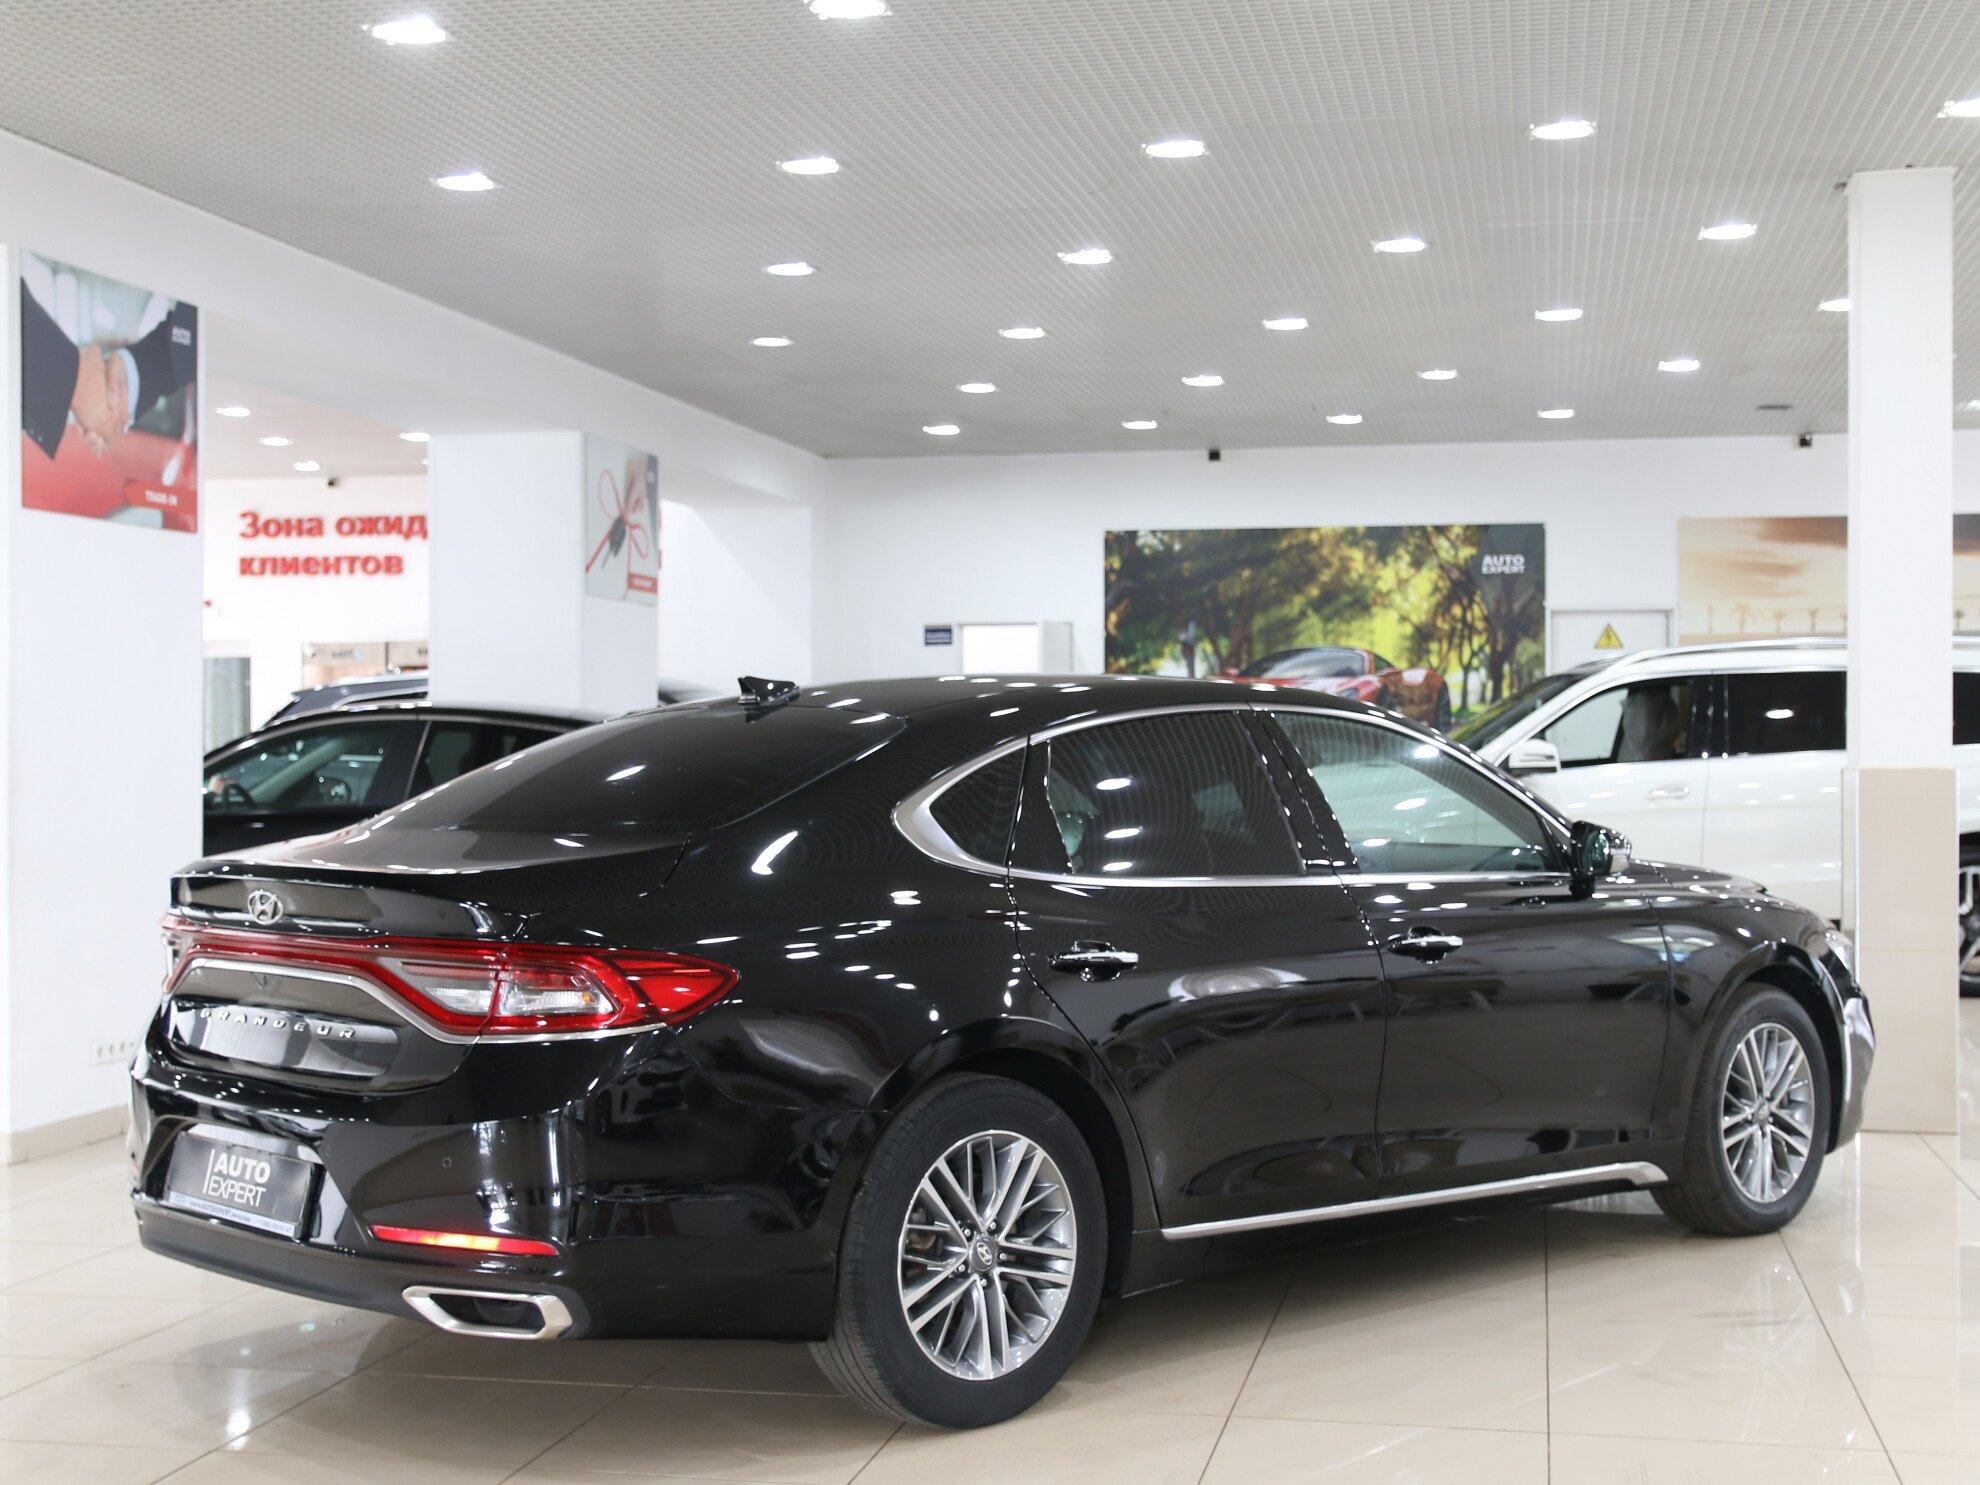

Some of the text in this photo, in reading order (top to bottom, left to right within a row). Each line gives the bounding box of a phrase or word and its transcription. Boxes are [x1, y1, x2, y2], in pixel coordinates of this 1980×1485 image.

[239, 510, 325, 538] Зона
[239, 555, 403, 576] клиентов
[1481, 564, 1525, 575] EXPERT
[1482, 553, 1525, 566] AUTO
[200, 1007, 355, 1039] GRANDEUR
[213, 1152, 271, 1184] AUTO
[208, 1175, 267, 1208] EXPERT
